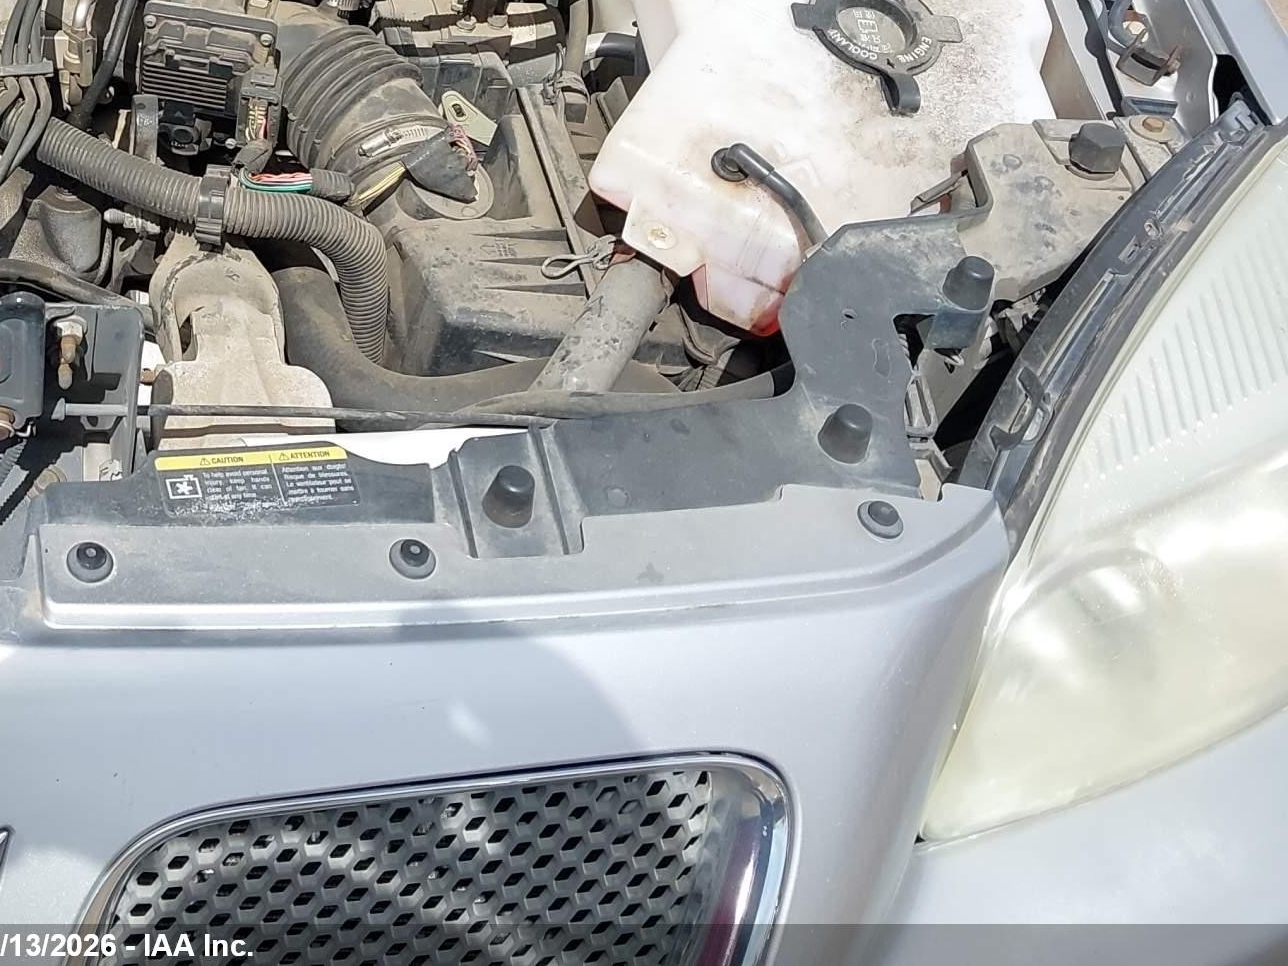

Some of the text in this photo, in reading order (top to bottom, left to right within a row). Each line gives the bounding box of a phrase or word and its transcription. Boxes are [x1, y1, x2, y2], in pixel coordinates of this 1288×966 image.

[896, 36, 932, 63] ENGINE
[290, 451, 330, 459] ATTENTION
[212, 457, 244, 465] CAUTION
[242, 468, 268, 477] personal
